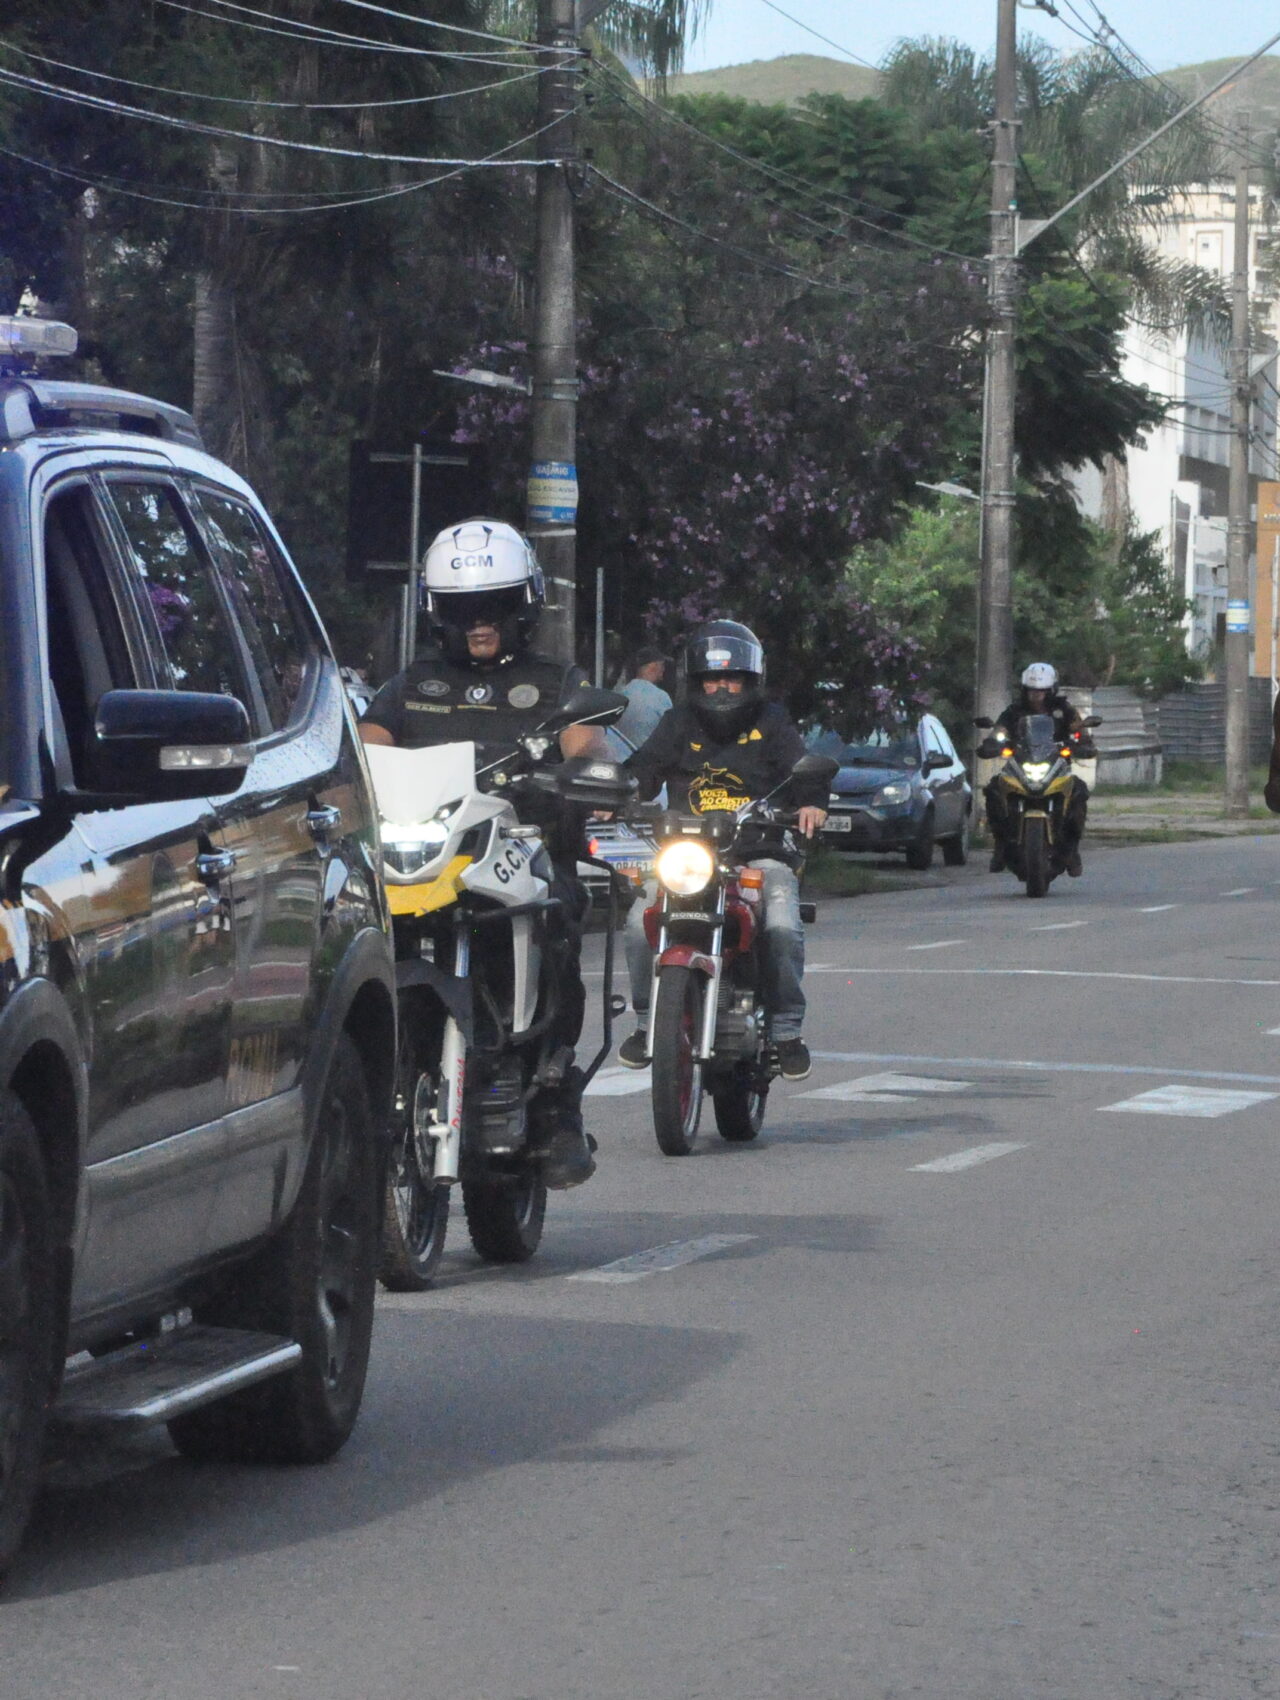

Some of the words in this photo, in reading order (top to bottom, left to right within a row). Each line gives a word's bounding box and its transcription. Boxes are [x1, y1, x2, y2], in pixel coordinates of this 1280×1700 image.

[450, 555, 493, 570] GCM
[699, 789, 728, 799] VOLTA
[700, 797, 714, 806] AO
[715, 797, 750, 808] CRISTO
